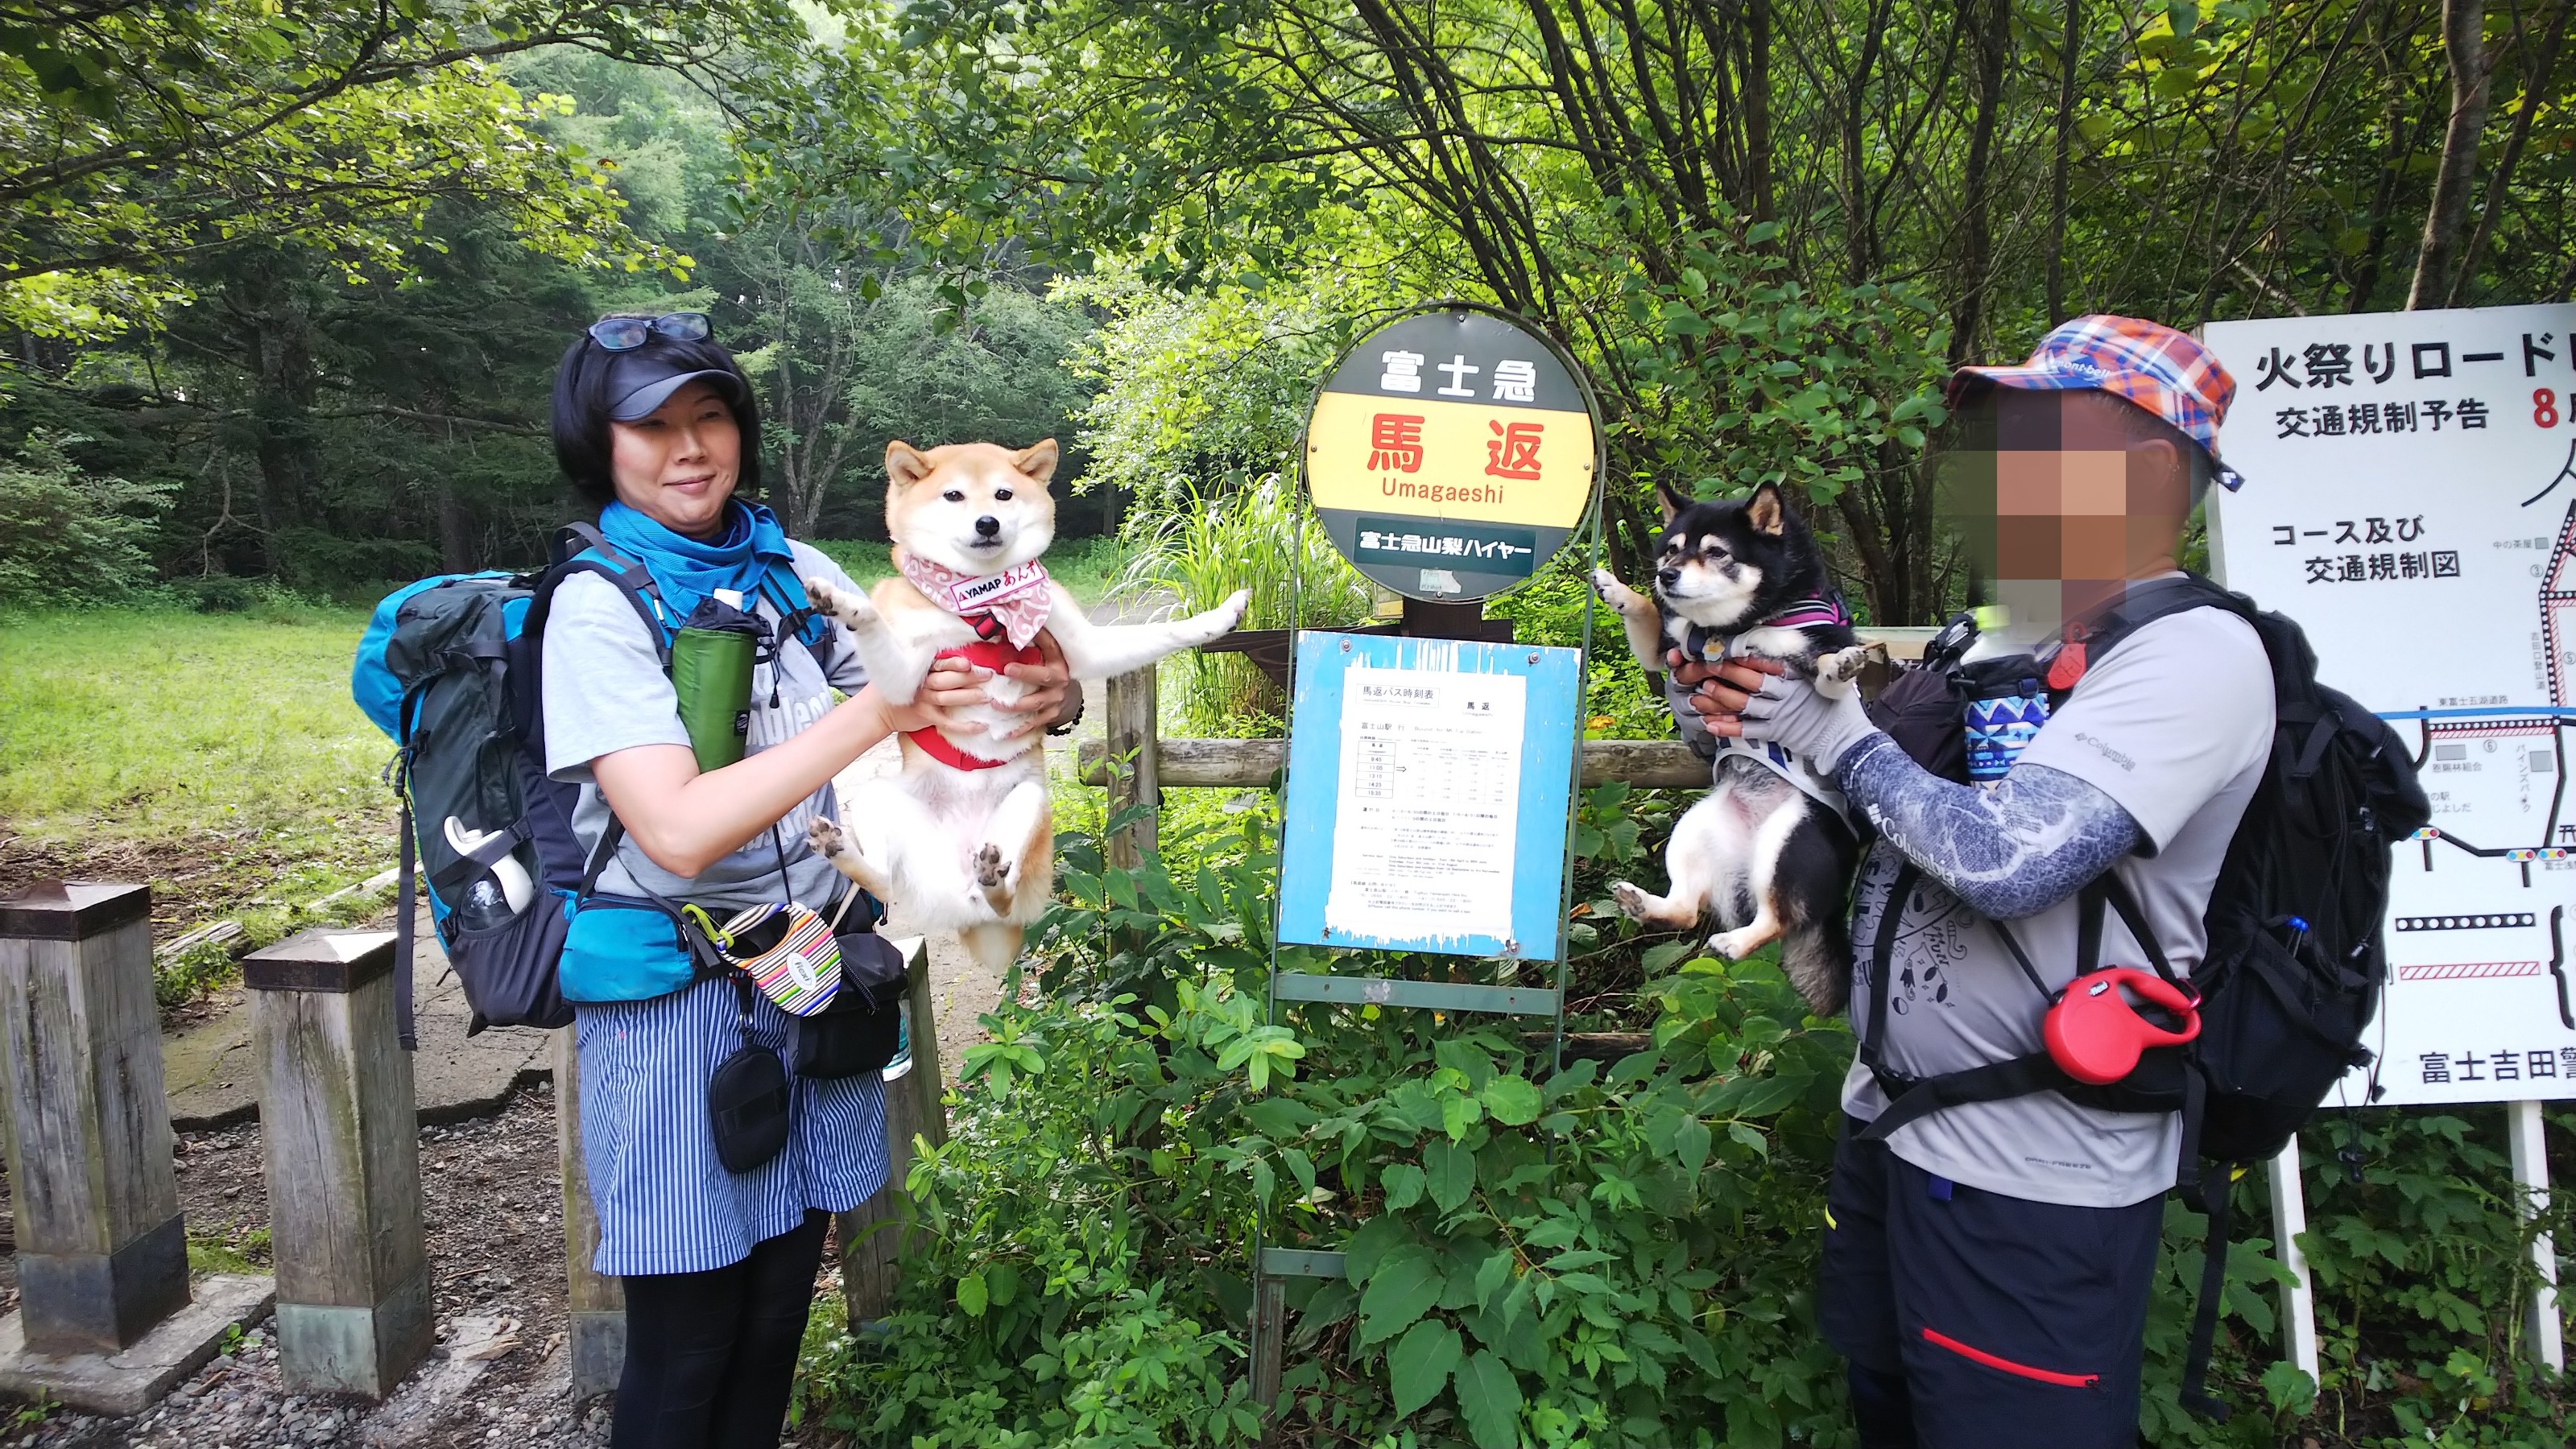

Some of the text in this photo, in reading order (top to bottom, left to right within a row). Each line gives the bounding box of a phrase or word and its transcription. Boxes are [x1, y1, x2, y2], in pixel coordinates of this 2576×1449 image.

[1380, 350, 1536, 402] 富士急
[2256, 332, 2576, 392] 火祭りロード
[2276, 398, 2489, 440] 交通規制予告
[1383, 477, 1503, 504] Umagaeshi
[1360, 531, 1532, 560] 富士急山梨ハイヤー
[2272, 514, 2425, 547] コース及び
[2493, 539, 2532, 549] 中の茶屋
[2305, 551, 2461, 584] 交通規制図
[965, 579, 1002, 600] YAMAP
[1362, 686, 1433, 700] 馬返バス時刻表
[2438, 696, 2508, 707] 東富士五湖道路
[2087, 737, 2136, 770] Columbia
[1882, 816, 1957, 888] Columbia
[795, 961, 812, 981] flexi
